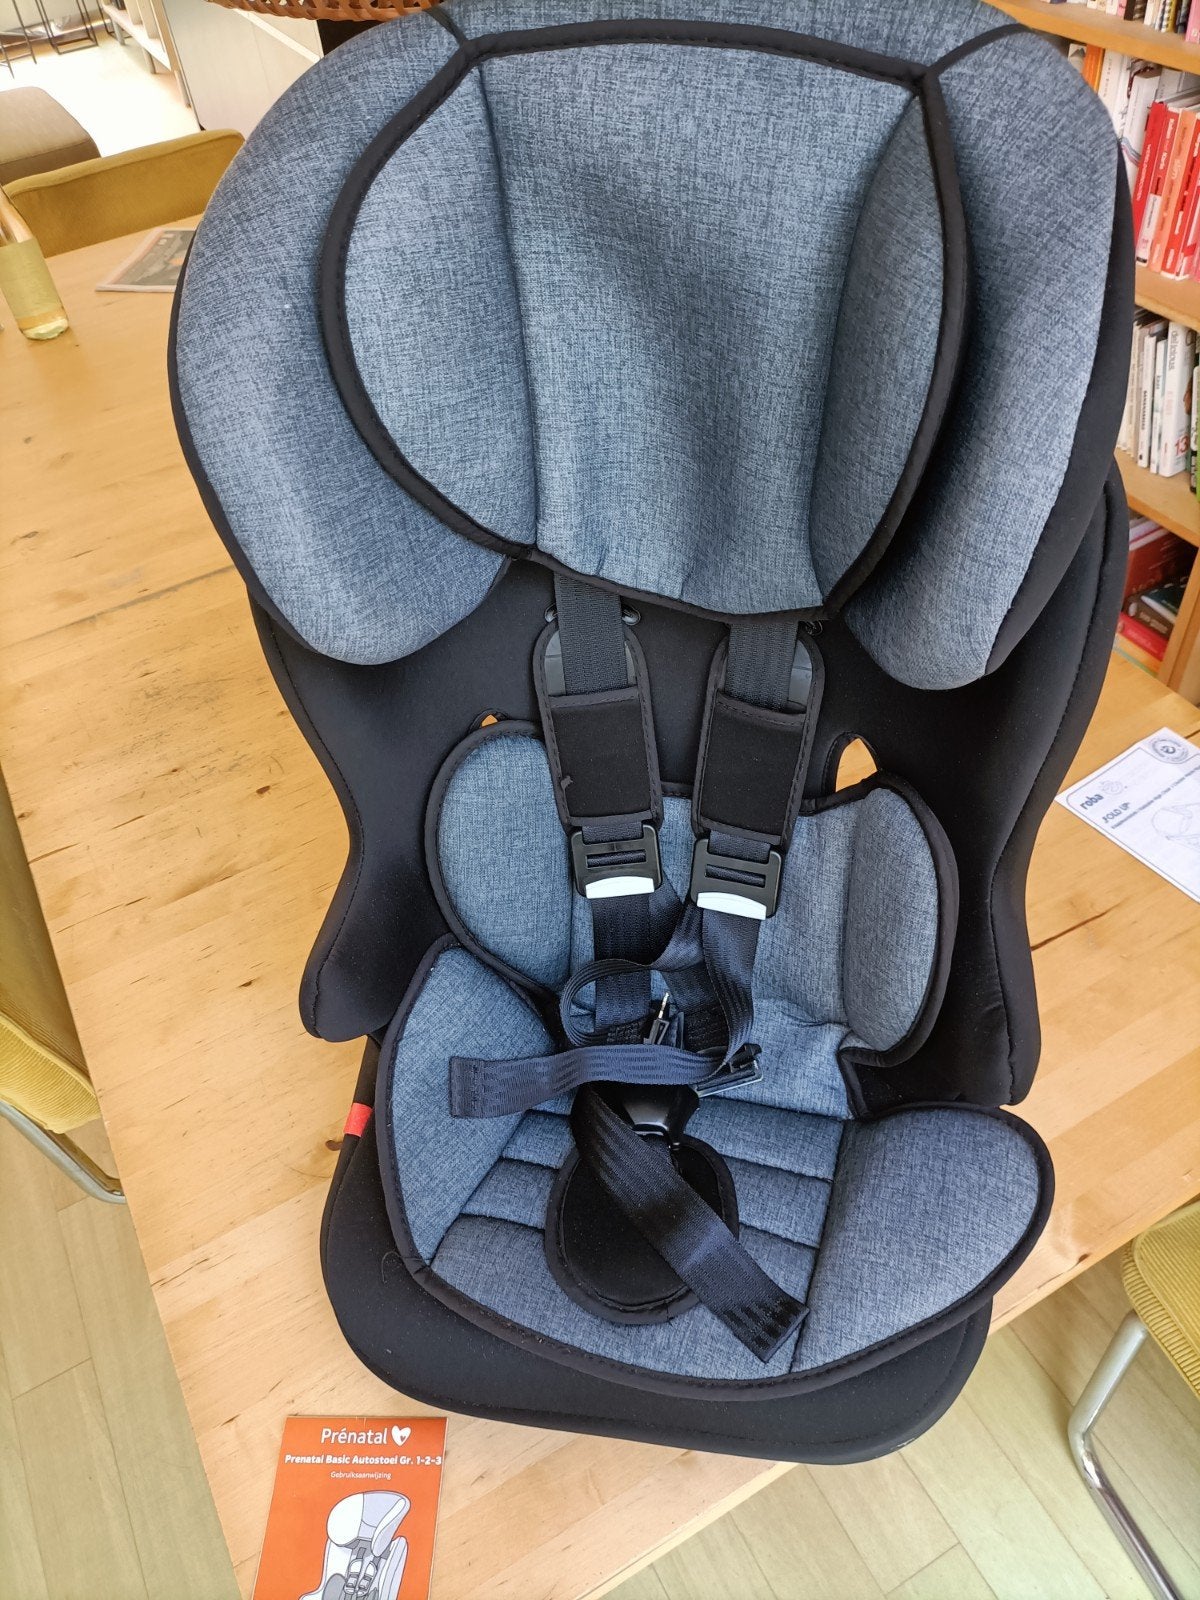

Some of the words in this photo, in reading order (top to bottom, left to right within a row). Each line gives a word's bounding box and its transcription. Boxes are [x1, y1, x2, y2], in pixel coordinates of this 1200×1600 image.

[1174, 435, 1189, 456] 13
[1080, 793, 1104, 810] roba
[320, 1427, 388, 1445] Prénatal
[284, 1454, 324, 1464] Prenatal
[325, 1455, 350, 1464] Basic
[352, 1455, 398, 1465] Autostoel
[399, 1456, 414, 1465] Gr.
[416, 1455, 442, 1465] 1-2-3
[330, 1471, 392, 1481] Gebruiksaanwijzing
